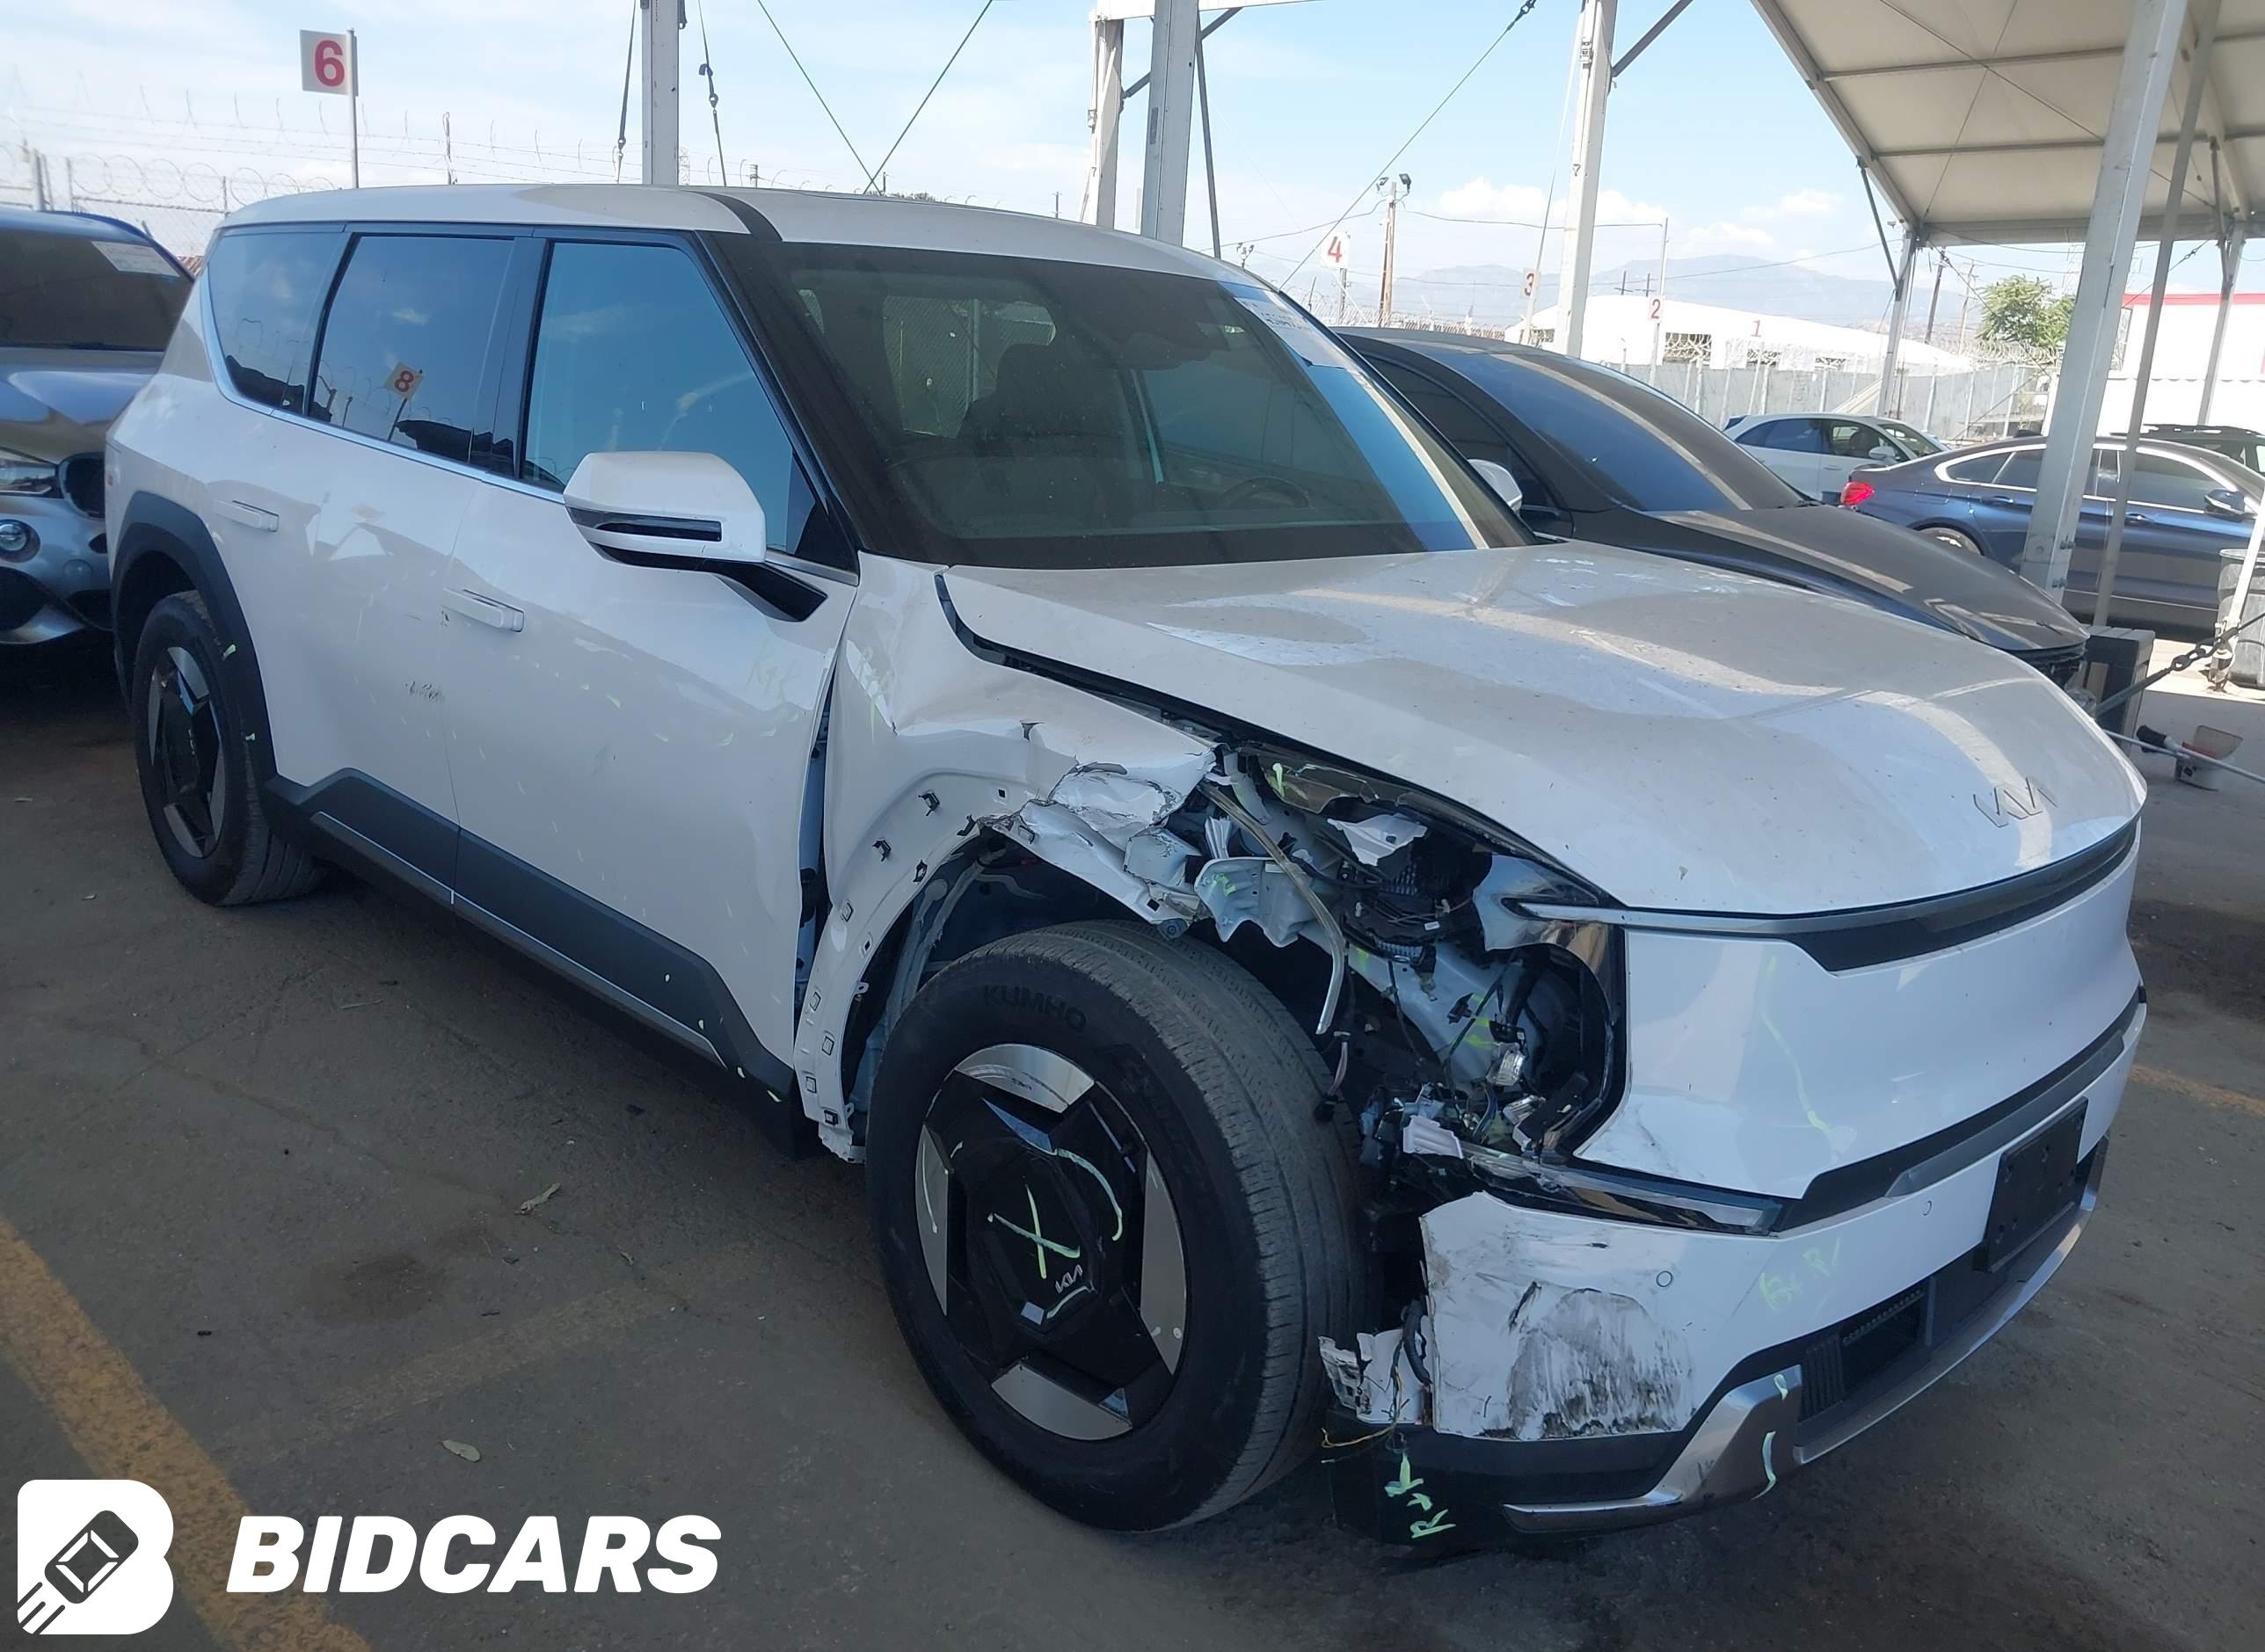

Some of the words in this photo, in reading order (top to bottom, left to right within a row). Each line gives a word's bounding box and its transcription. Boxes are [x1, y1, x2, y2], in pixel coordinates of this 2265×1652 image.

[315, 40, 345, 86] 6
[1328, 237, 1342, 263] 4
[1525, 273, 1535, 296] 3
[1651, 299, 1661, 319] 2
[1752, 319, 1761, 338] 1
[984, 985, 1087, 1032] KUMHO
[1055, 1264, 1083, 1293] KIA
